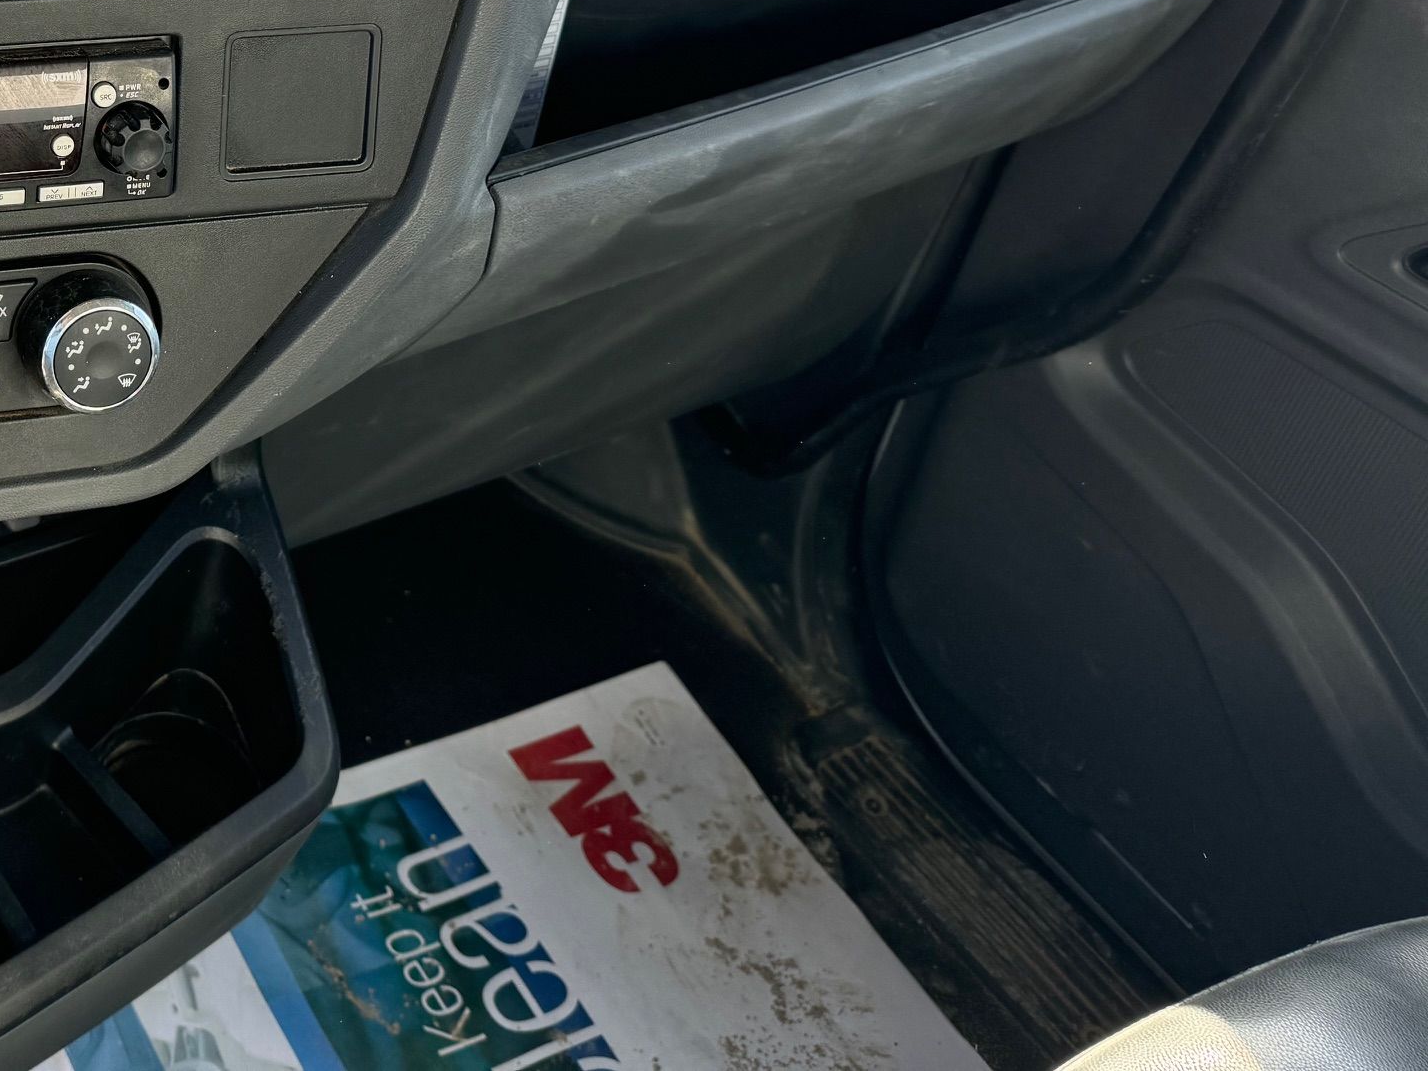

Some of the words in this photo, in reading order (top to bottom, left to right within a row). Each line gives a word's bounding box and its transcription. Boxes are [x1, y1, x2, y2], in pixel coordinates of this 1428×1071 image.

[126, 83, 141, 91] PWR
[132, 181, 151, 189] MENU
[508, 725, 679, 893] 3M
[351, 885, 403, 923] it
[385, 929, 487, 1056] Keep
